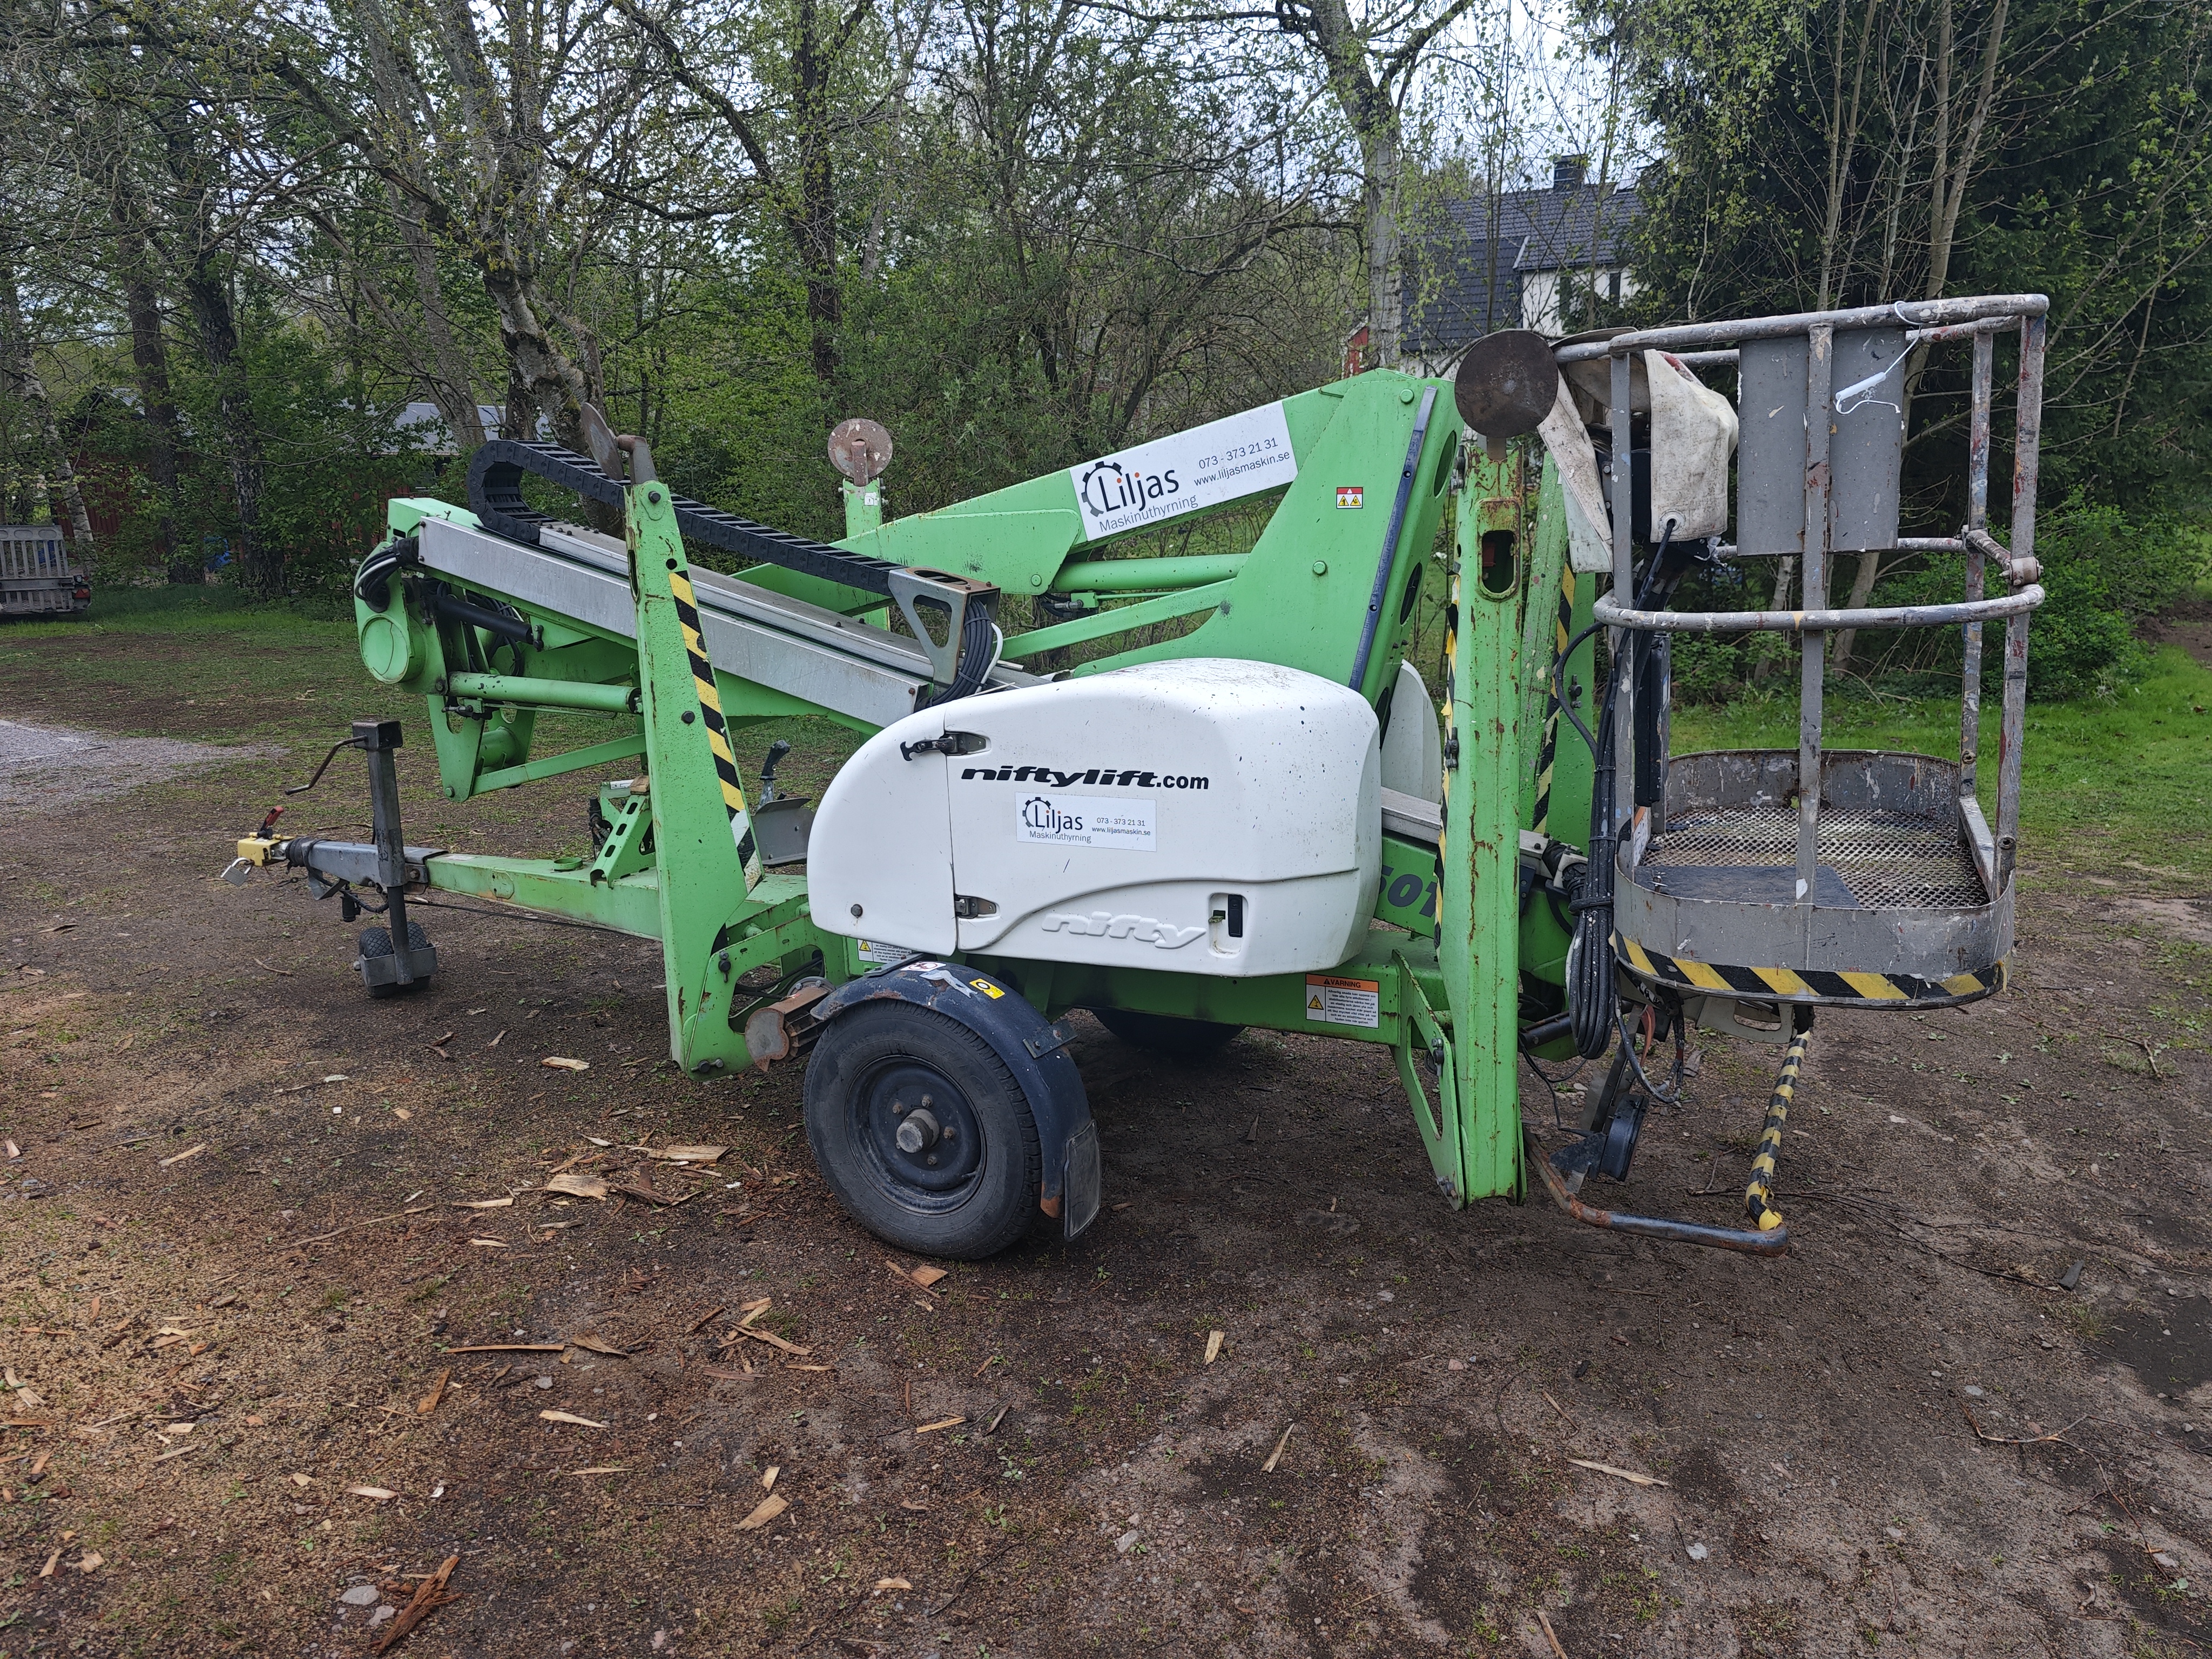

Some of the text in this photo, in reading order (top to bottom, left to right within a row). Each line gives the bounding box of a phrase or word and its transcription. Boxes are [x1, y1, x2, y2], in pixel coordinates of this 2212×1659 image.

[1199, 456, 1218, 469] 073
[1226, 447, 1246, 461] 373
[1248, 442, 1262, 454] 21
[1264, 437, 1278, 449] 31
[1194, 452, 1290, 486] www.liljasmaskin.se
[1098, 469, 1179, 512] Liljas
[1099, 495, 1198, 532] Maskinuthyrning
[961, 766, 1209, 790] niftylift.com
[1035, 805, 1083, 834] Liljas
[1091, 827, 1151, 836] www.liljasmaskin.se
[1029, 831, 1091, 844] Maskinuthyrning
[1041, 911, 1206, 949] nifty
[1330, 979, 1361, 988] VARNING
